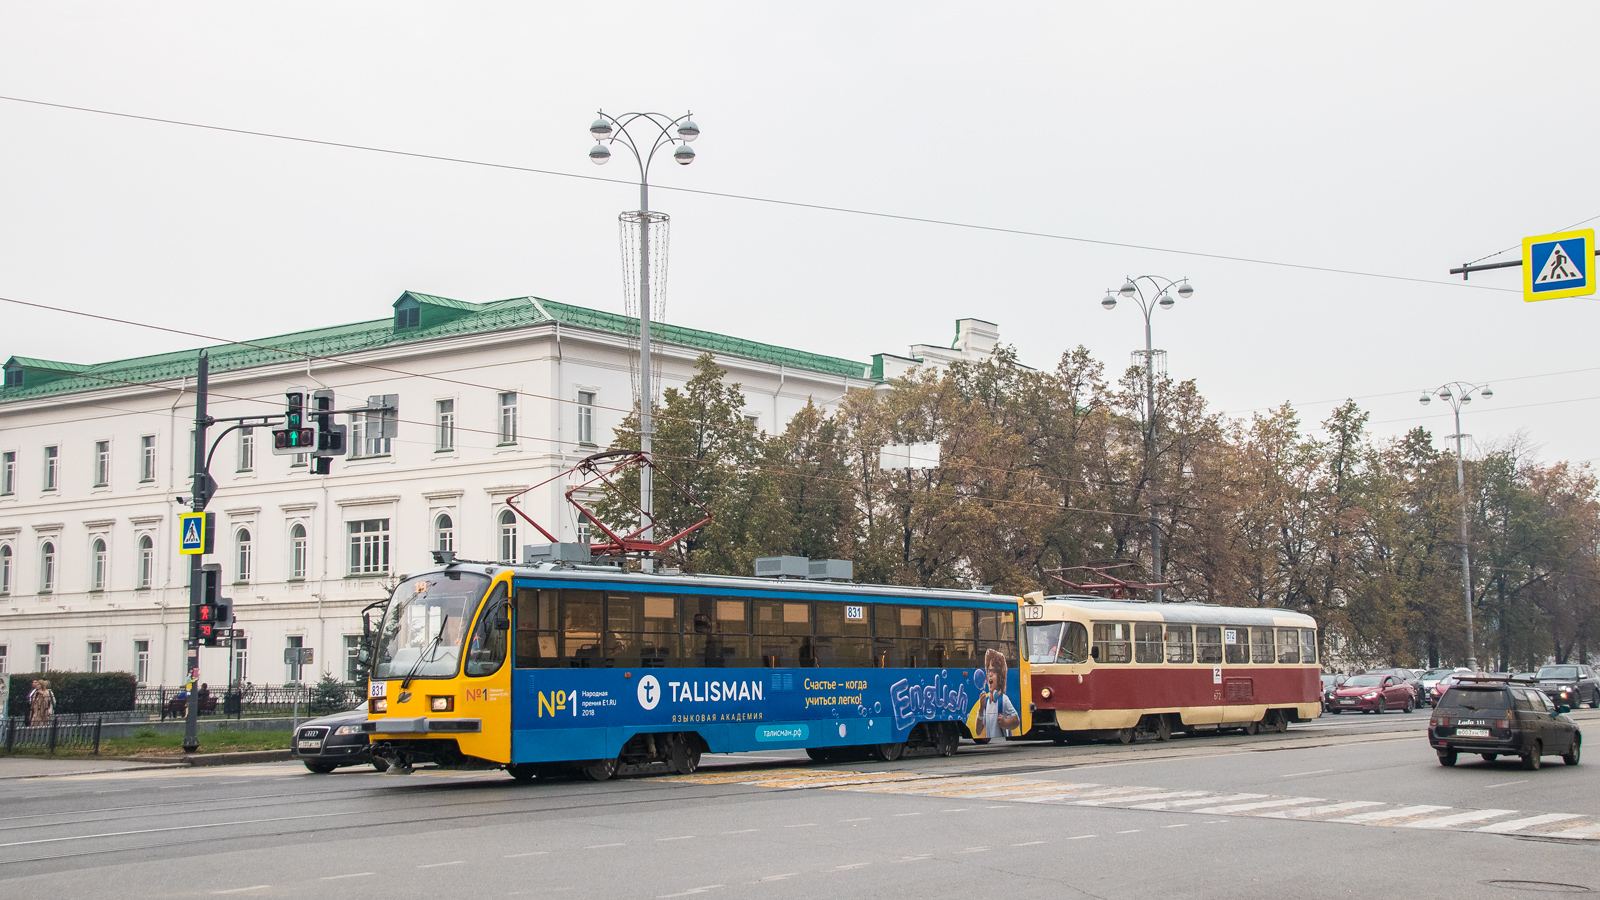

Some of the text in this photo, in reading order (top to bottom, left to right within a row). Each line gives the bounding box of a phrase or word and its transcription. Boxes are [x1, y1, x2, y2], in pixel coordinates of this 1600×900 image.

[291, 415, 300, 425] 41
[414, 581, 427, 593] 19
[847, 606, 862, 618] 831
[1028, 606, 1039, 619] 18
[1214, 668, 1221, 677] 2
[803, 678, 837, 691] Счастье
[845, 680, 868, 690] когда
[371, 685, 384, 697] 831
[581, 690, 609, 699] Народная
[804, 693, 863, 709] учиться легко!
[889, 673, 969, 731] English
[581, 708, 596, 717] 2018
[671, 712, 763, 723] ЯЗЫКОВАЯ АКАДЕМИЯ
[763, 728, 802, 738] талисман.рф
